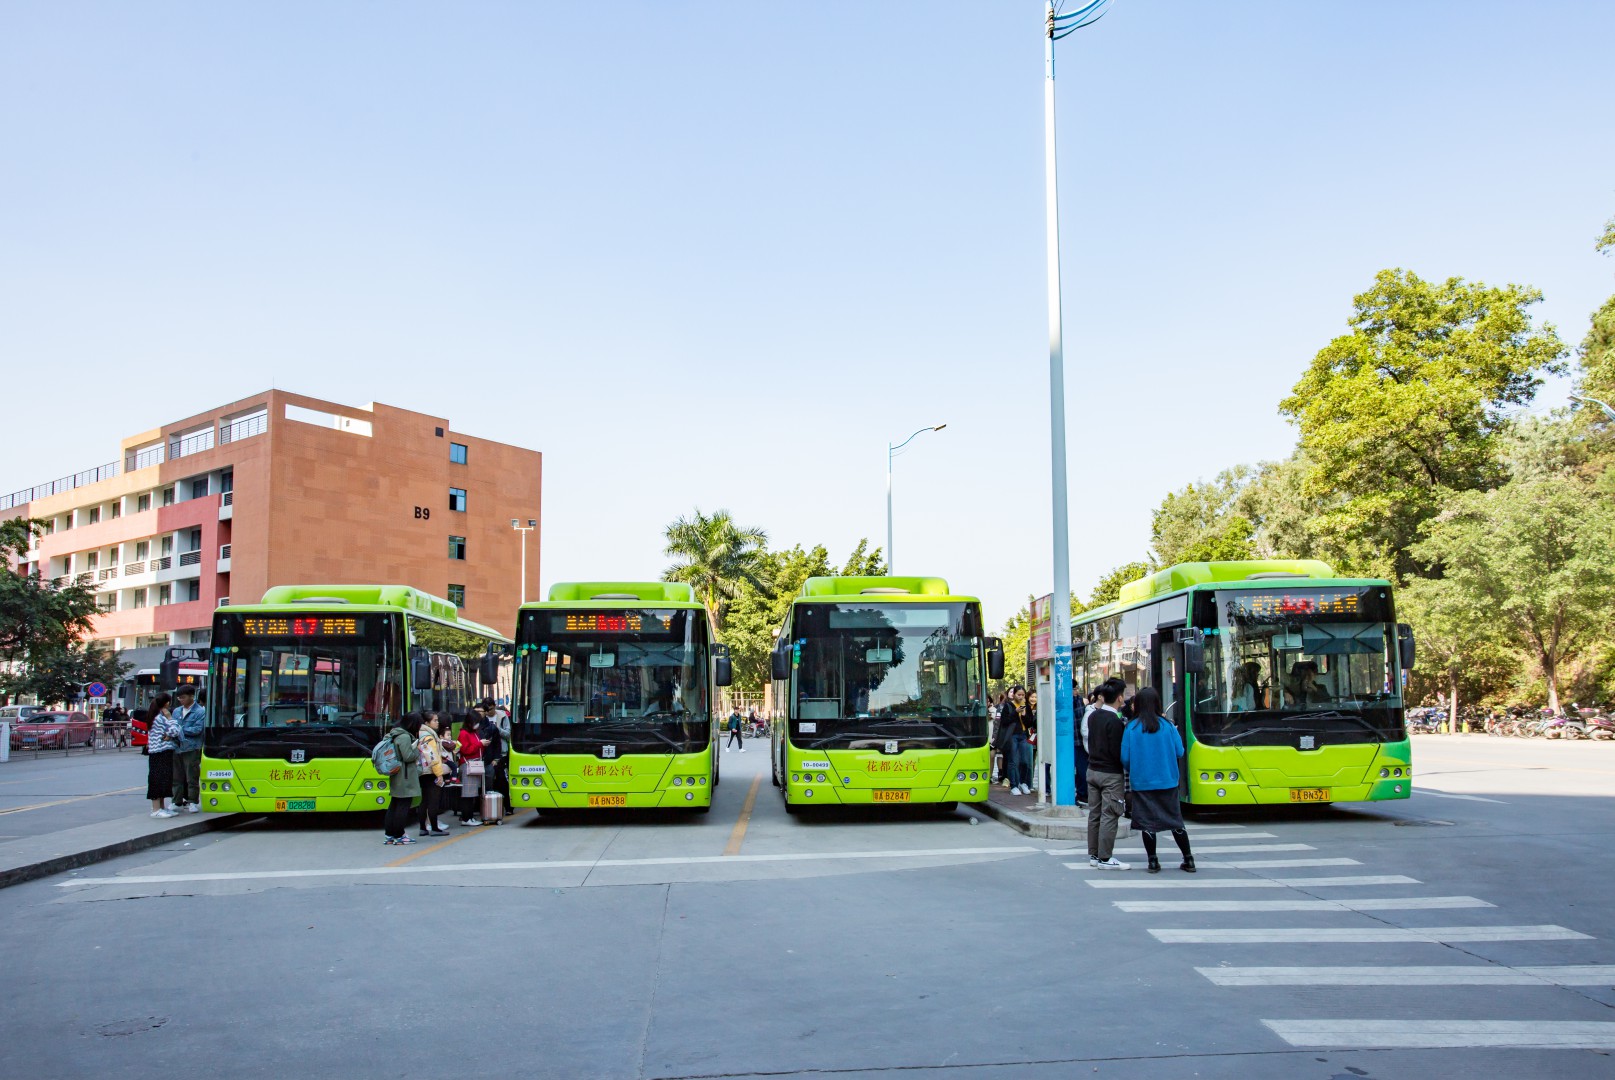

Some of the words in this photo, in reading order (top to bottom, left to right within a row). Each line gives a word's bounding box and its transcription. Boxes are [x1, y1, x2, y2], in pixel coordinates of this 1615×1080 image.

[414, 506, 430, 520] B9
[582, 764, 633, 777] 花都公汽
[867, 760, 918, 772] 花都公汽
[269, 768, 321, 781] 花都公汽
